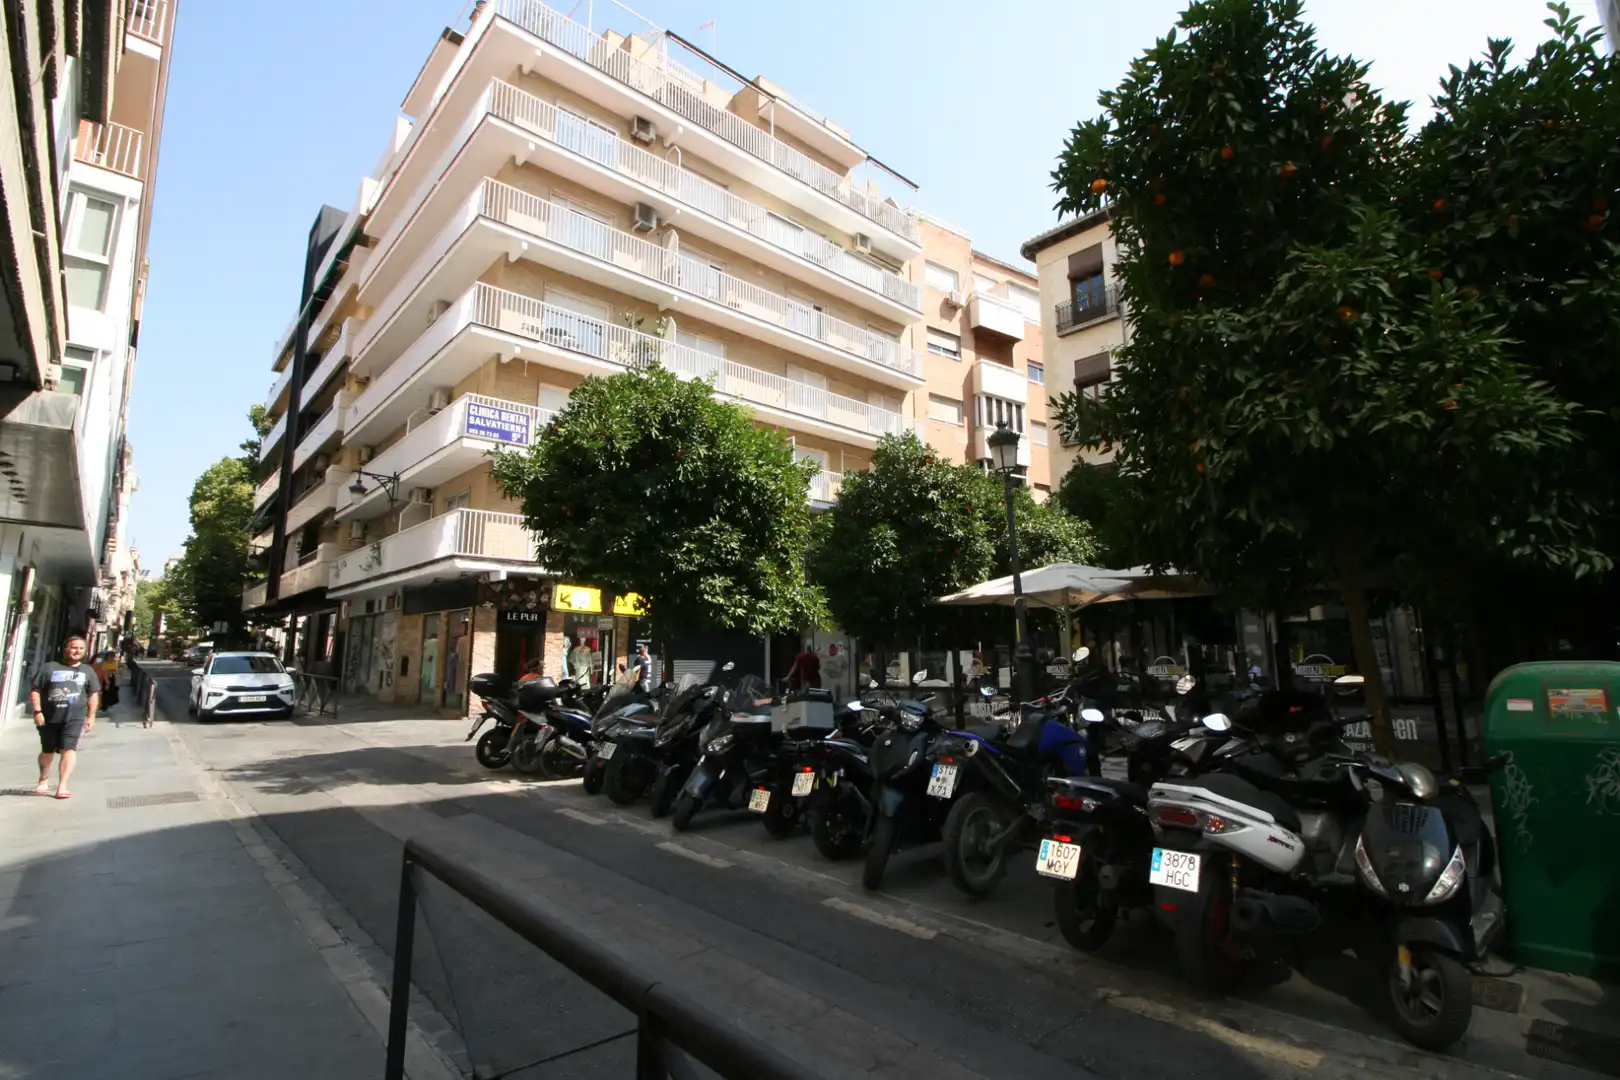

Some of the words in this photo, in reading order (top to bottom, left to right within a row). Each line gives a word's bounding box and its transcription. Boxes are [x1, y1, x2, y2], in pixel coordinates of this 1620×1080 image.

[469, 416, 527, 434] SALVATIERRA
[501, 411, 528, 426] DENTAL
[507, 612, 519, 621] LE
[520, 613, 538, 621] PUR
[1051, 844, 1078, 860] 1607
[1164, 851, 1196, 871] 3878
[1165, 869, 1190, 887] HGC
